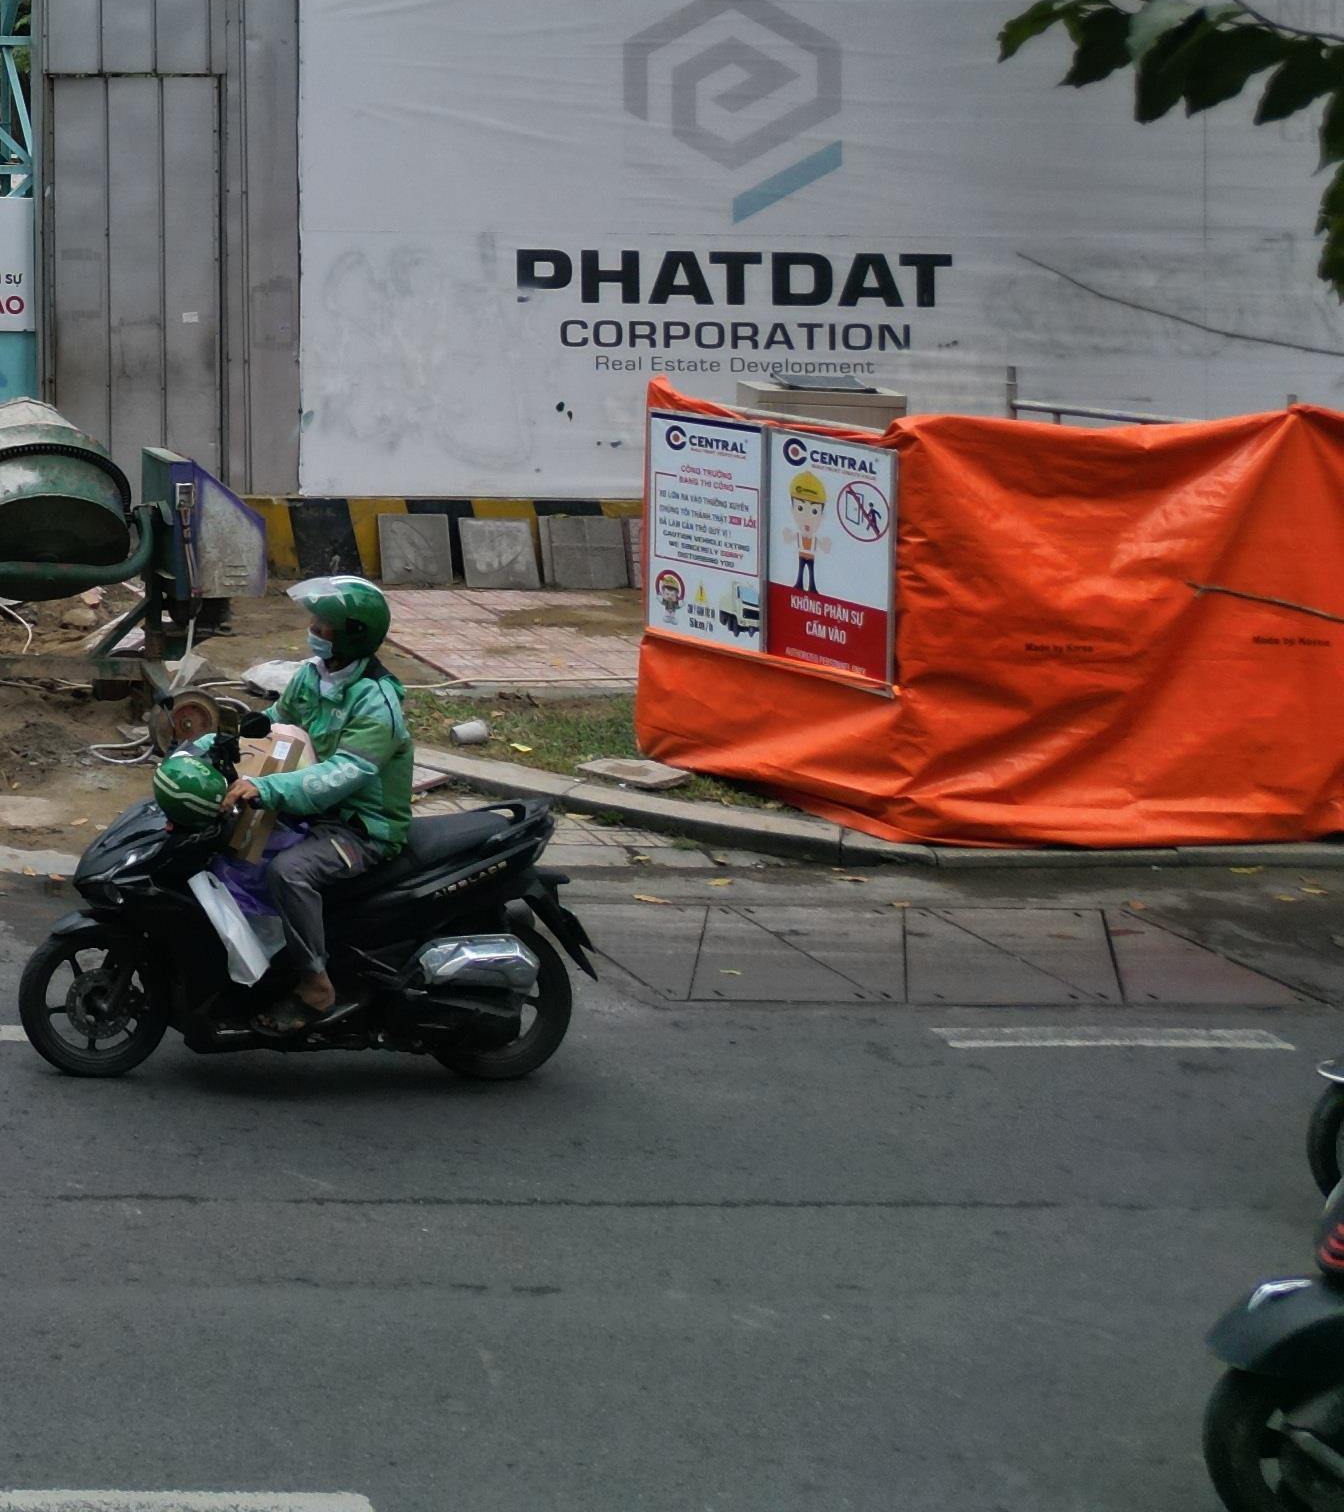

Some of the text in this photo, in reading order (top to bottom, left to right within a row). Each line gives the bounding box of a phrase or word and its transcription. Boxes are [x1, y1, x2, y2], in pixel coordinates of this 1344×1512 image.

[5, 273, 23, 286] SỰ
[516, 249, 953, 308] PHATDAT
[560, 319, 911, 351] CORPORATION
[595, 355, 874, 375] Real Estate Development
[689, 435, 746, 454] CENTRAL
[809, 450, 877, 475] CENTRAL
[790, 593, 822, 616] KHÔNG
[823, 603, 849, 624] PHẬN
[805, 619, 847, 645] CẤM VÀO
